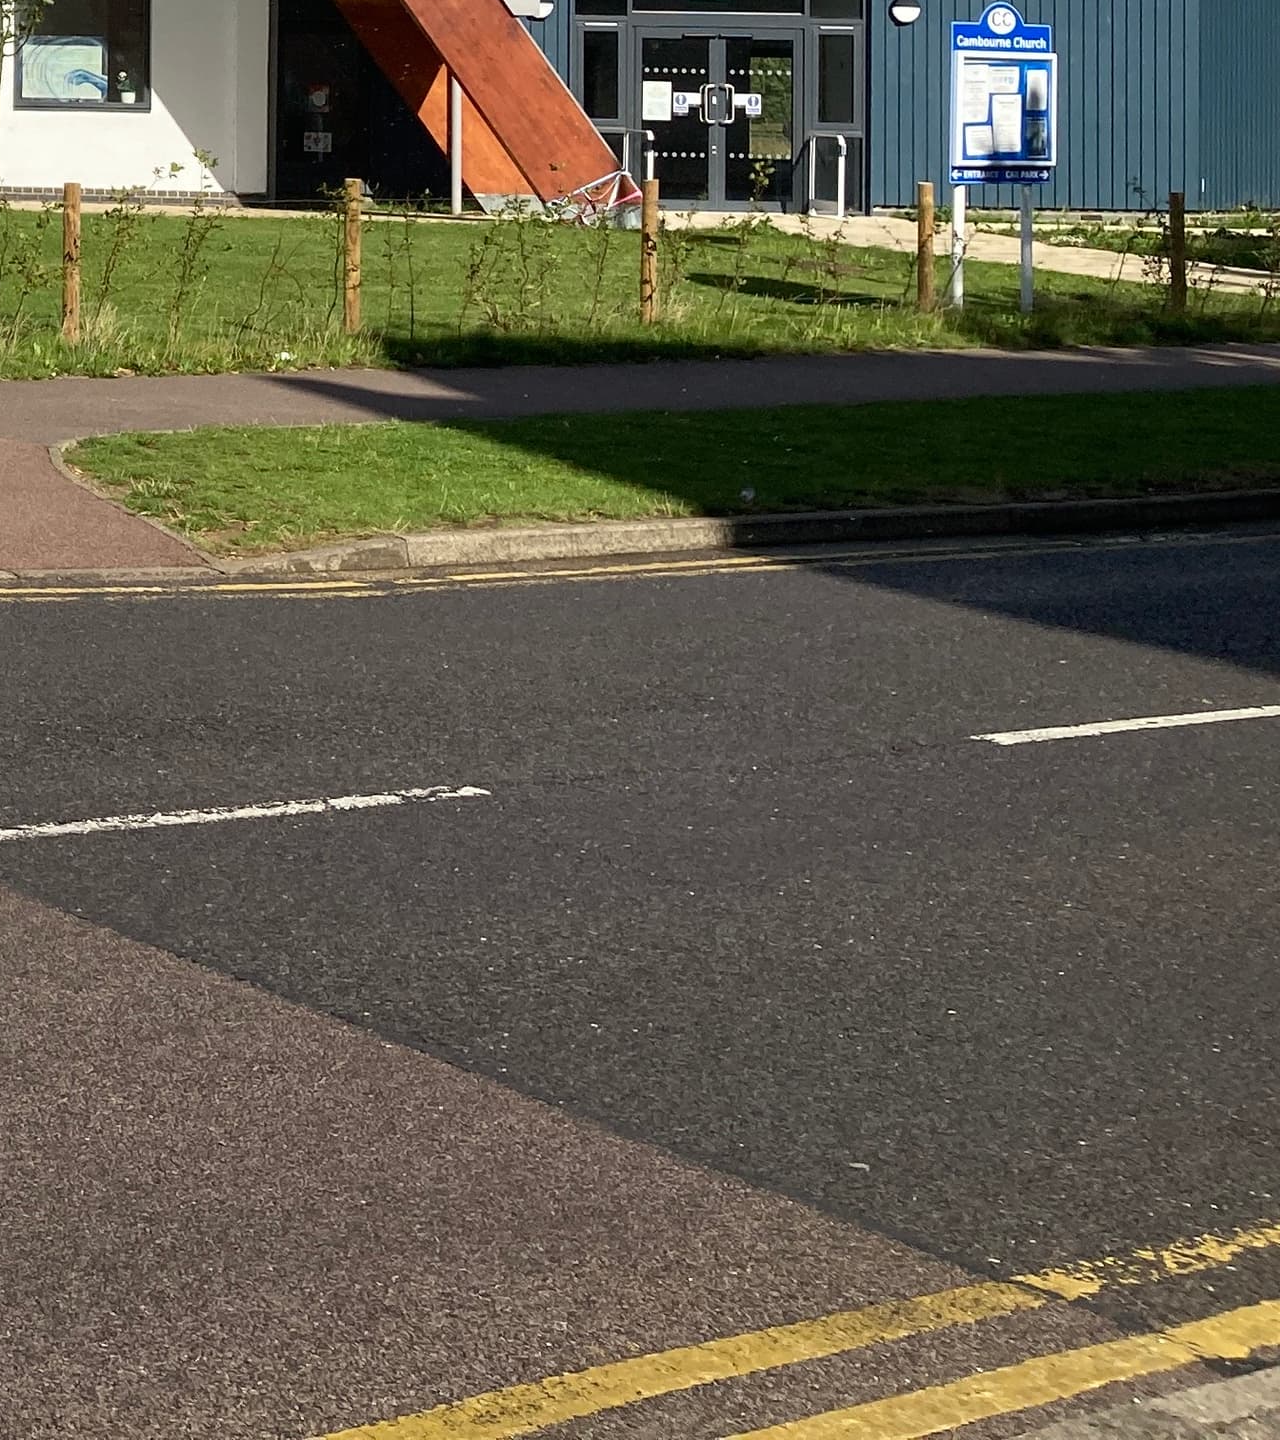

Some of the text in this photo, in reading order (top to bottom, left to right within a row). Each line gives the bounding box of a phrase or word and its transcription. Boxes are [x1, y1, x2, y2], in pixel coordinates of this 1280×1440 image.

[991, 11, 1012, 27] CC
[956, 34, 1047, 49] Cambourne Church
[1020, 170, 1039, 179] PARK
